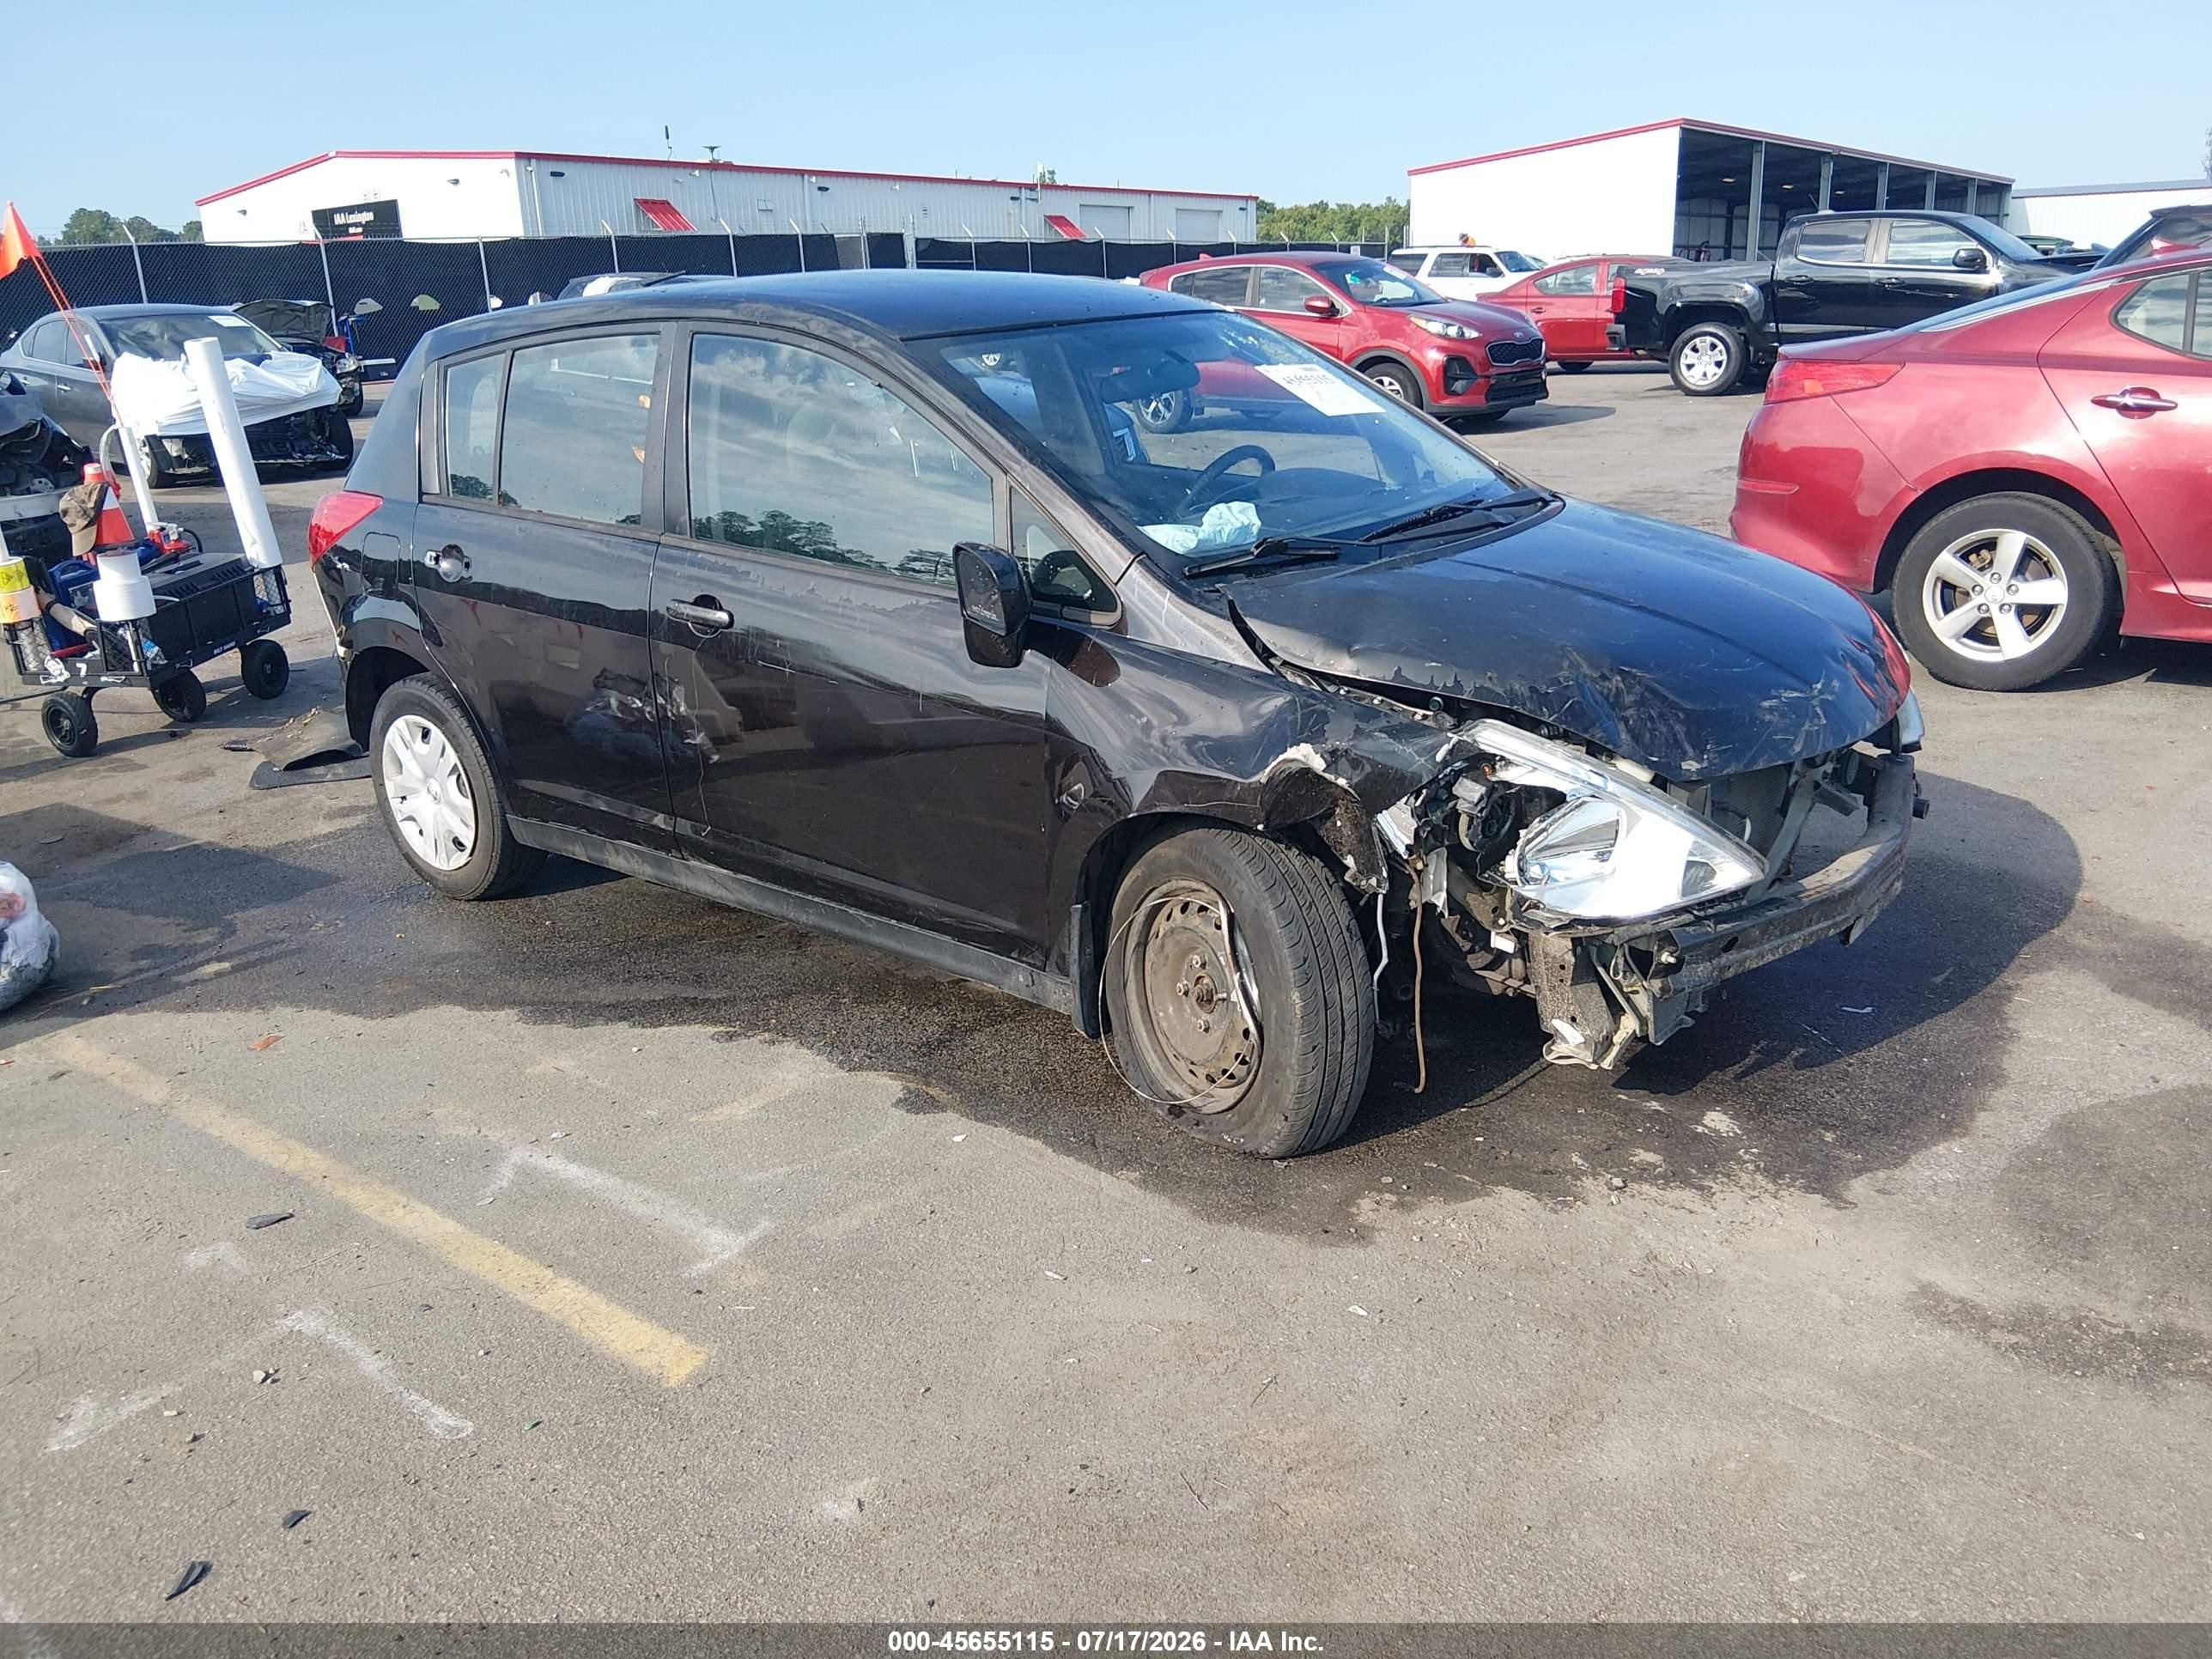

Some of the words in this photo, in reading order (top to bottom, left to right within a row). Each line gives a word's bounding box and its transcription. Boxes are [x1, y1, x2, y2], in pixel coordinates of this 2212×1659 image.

[333, 213, 346, 225] IAA
[346, 210, 374, 224] Lexington
[76, 663, 87, 678] 7
